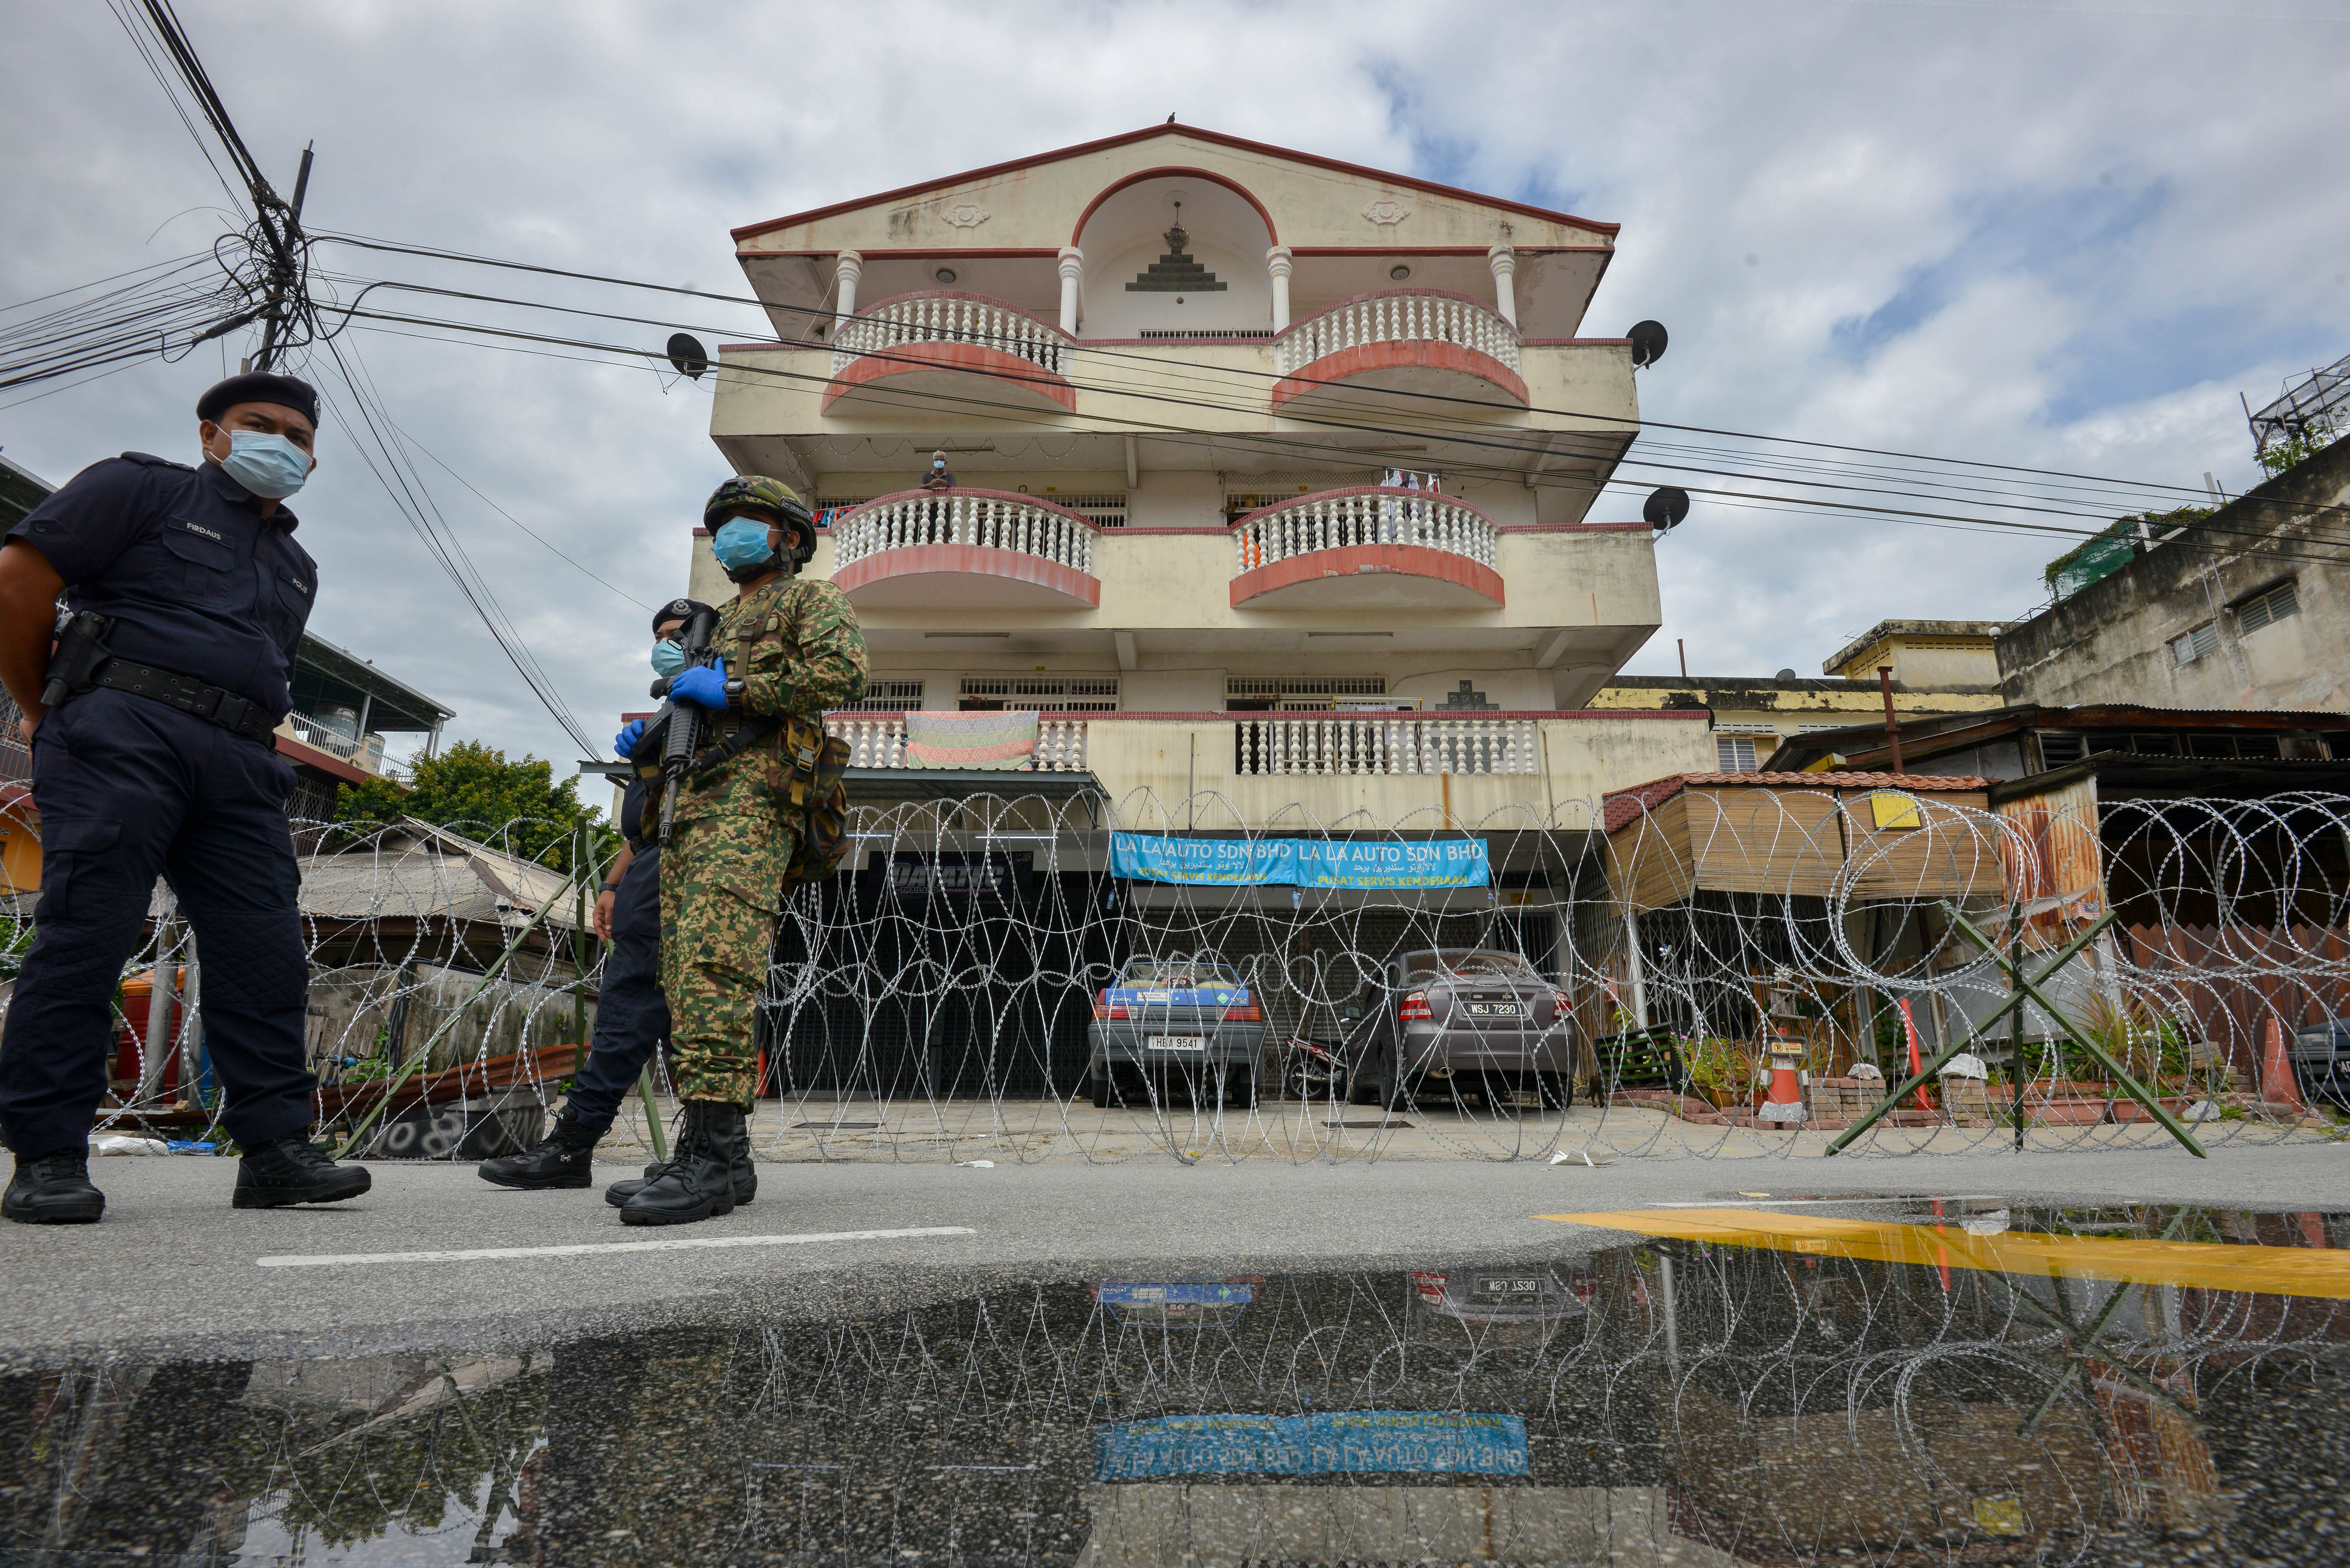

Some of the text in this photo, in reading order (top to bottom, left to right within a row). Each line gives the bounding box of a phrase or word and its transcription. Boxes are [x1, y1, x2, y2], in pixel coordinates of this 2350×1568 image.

[187, 523, 221, 540] FIRDAUS
[292, 578, 308, 593] POLIS
[1116, 837, 1291, 859] LA LA AUTO SDN BHD
[1299, 844, 1482, 862] LA LA AUTO SDN BHD
[1138, 867, 1267, 881] PUSAT SERVIS KENDERAAN
[1318, 875, 1468, 886] PUSAT SERVIS KENDERAAN
[1471, 1005, 1516, 1014] WSJ 7230
[1176, 1039, 1197, 1048] 9541
